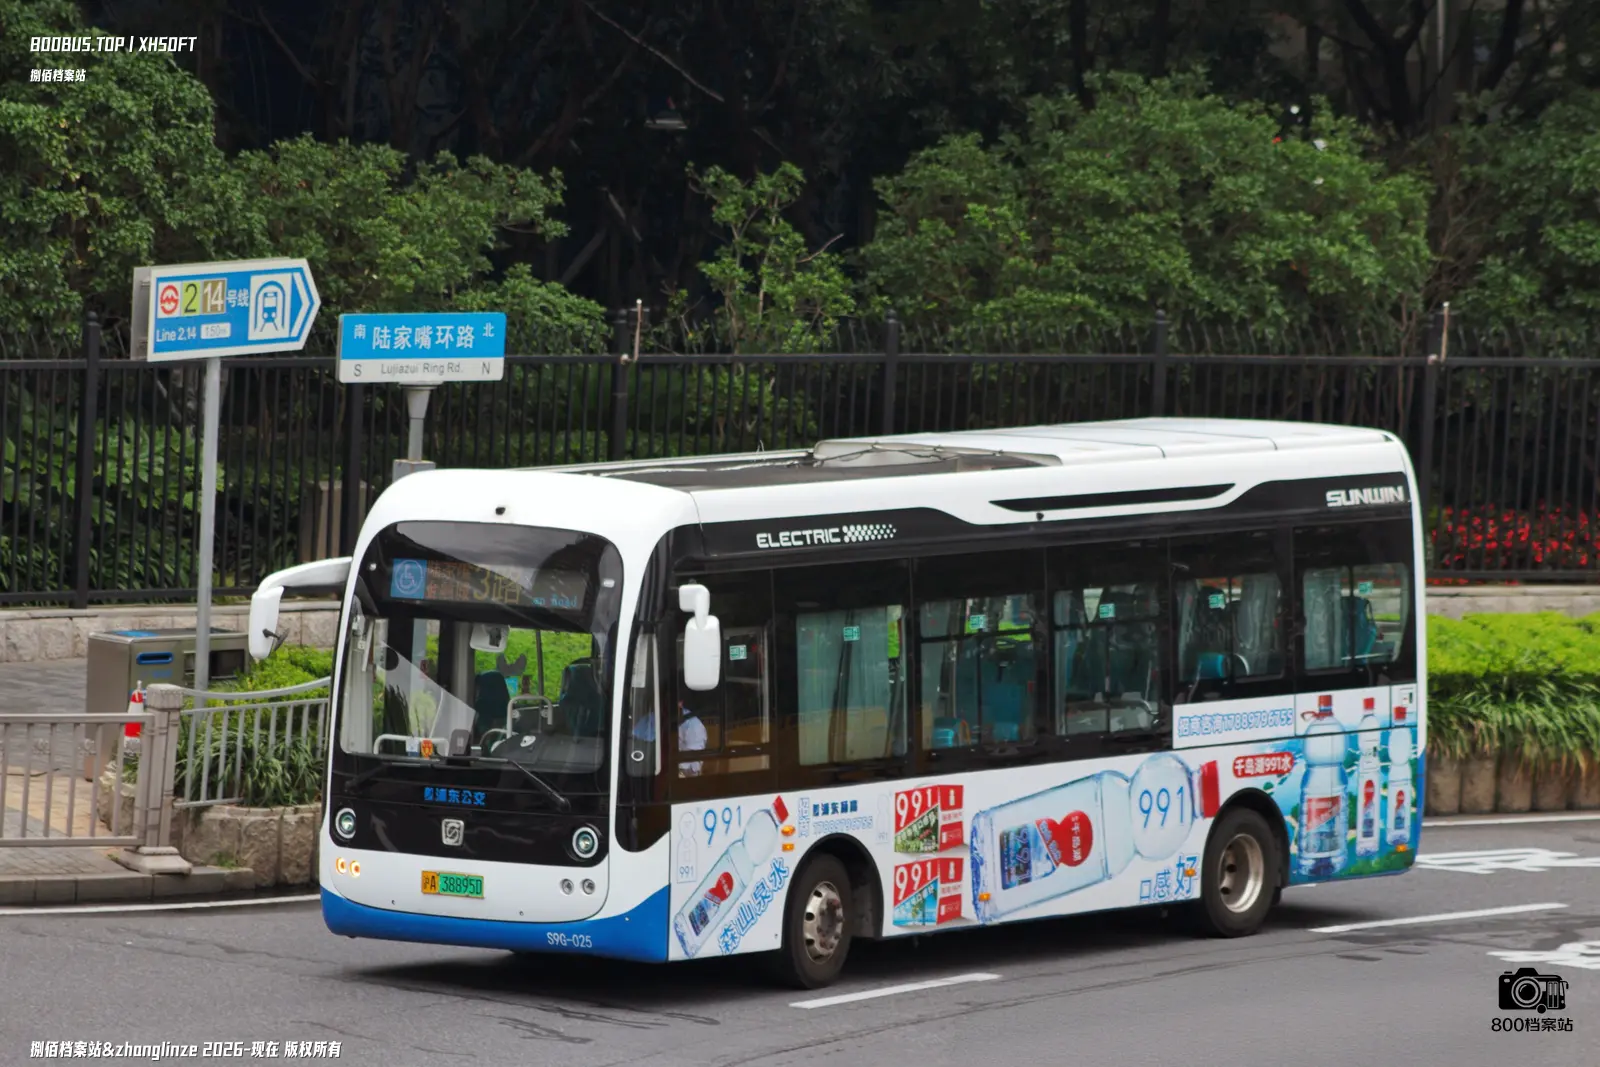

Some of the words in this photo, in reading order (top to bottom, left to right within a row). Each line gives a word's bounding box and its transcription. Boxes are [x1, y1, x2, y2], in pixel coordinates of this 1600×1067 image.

[184, 283, 198, 313] 2
[204, 281, 224, 312] 14
[226, 288, 250, 307] 号线
[155, 328, 177, 342] Line
[353, 324, 367, 339] 南
[372, 325, 475, 350] 陆家嘴环路
[483, 322, 495, 338] 北
[353, 364, 363, 377] S
[381, 364, 420, 376] Lujiazui
[423, 362, 445, 376] Ring
[447, 362, 464, 373] Rd.
[482, 362, 491, 374] N
[1325, 485, 1405, 508] SUNWIN
[756, 527, 841, 549] ELECTRIC
[1234, 754, 1292, 776] 千岛湖991水
[896, 788, 932, 828] 991
[1138, 785, 1184, 829] 991
[702, 804, 743, 847] 991
[895, 861, 932, 901] 991
[1138, 854, 1198, 900] 口感好
[717, 857, 790, 956] 森山泉水
[546, 931, 593, 949] S9G-025
